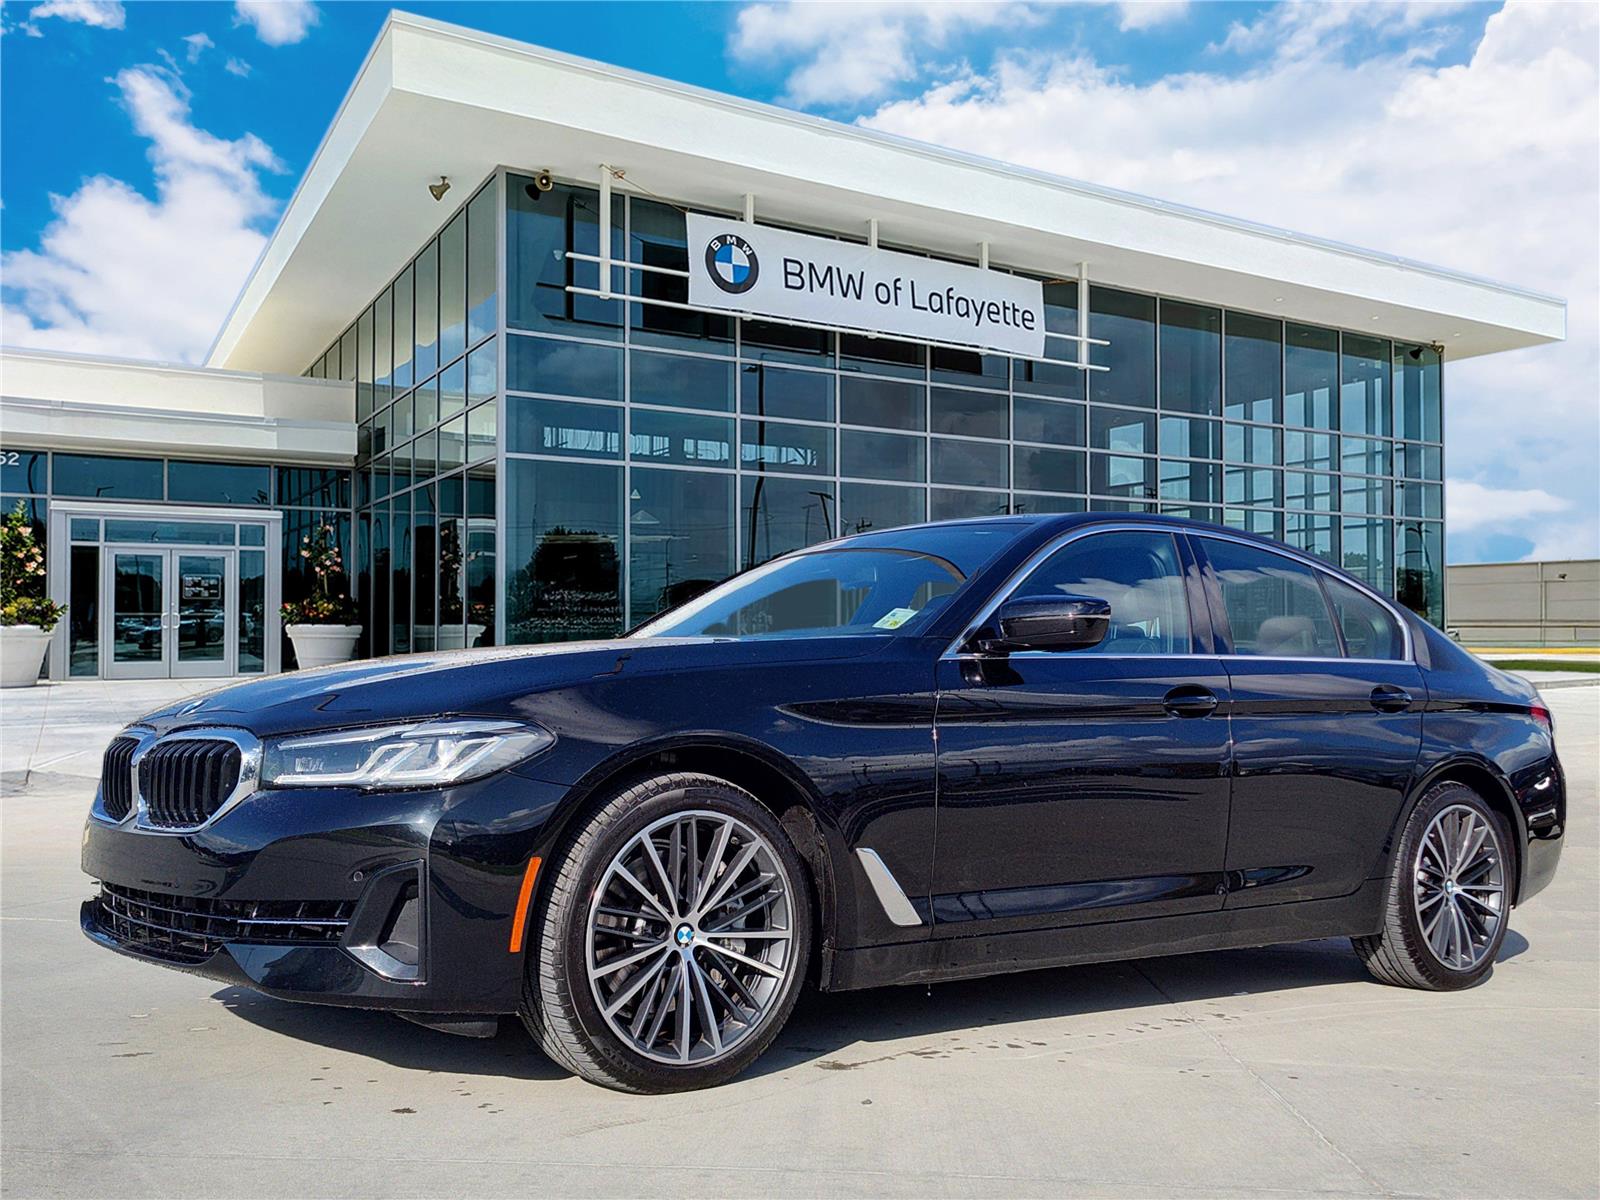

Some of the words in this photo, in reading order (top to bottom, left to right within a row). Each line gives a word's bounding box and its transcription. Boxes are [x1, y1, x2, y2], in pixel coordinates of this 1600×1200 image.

[710, 235, 753, 256] BMW
[783, 257, 865, 301] BMW
[874, 277, 902, 307] of
[910, 280, 1036, 331] Lafayette
